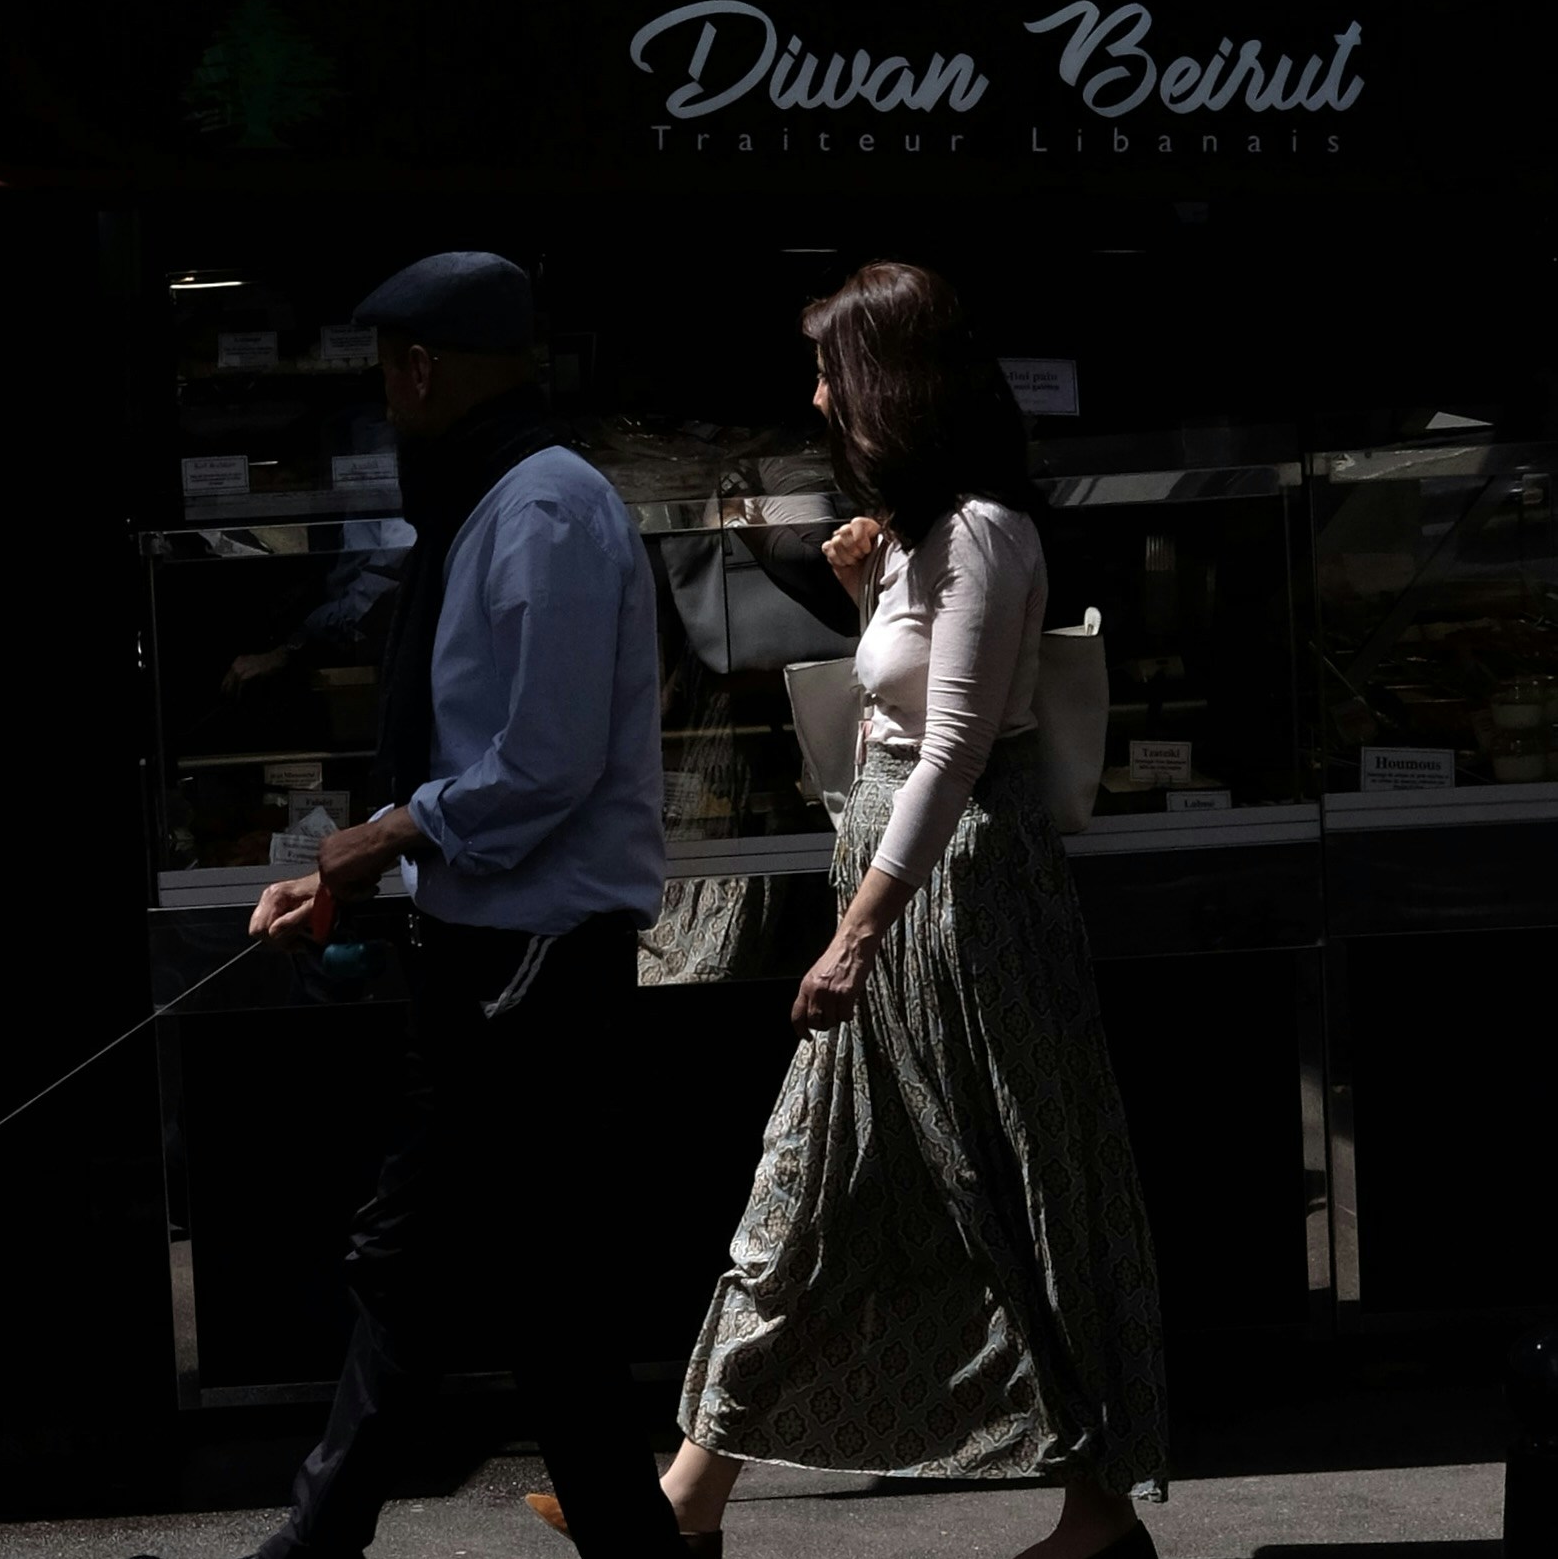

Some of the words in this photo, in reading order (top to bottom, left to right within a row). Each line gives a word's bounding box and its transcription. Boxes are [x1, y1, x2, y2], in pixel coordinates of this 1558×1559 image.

[630, 0, 989, 119] Diwan
[1024, 0, 1364, 118] Beirut
[650, 125, 966, 153] Traiteur
[1031, 126, 1341, 154] Libanais
[1374, 756, 1442, 770] Houmous
